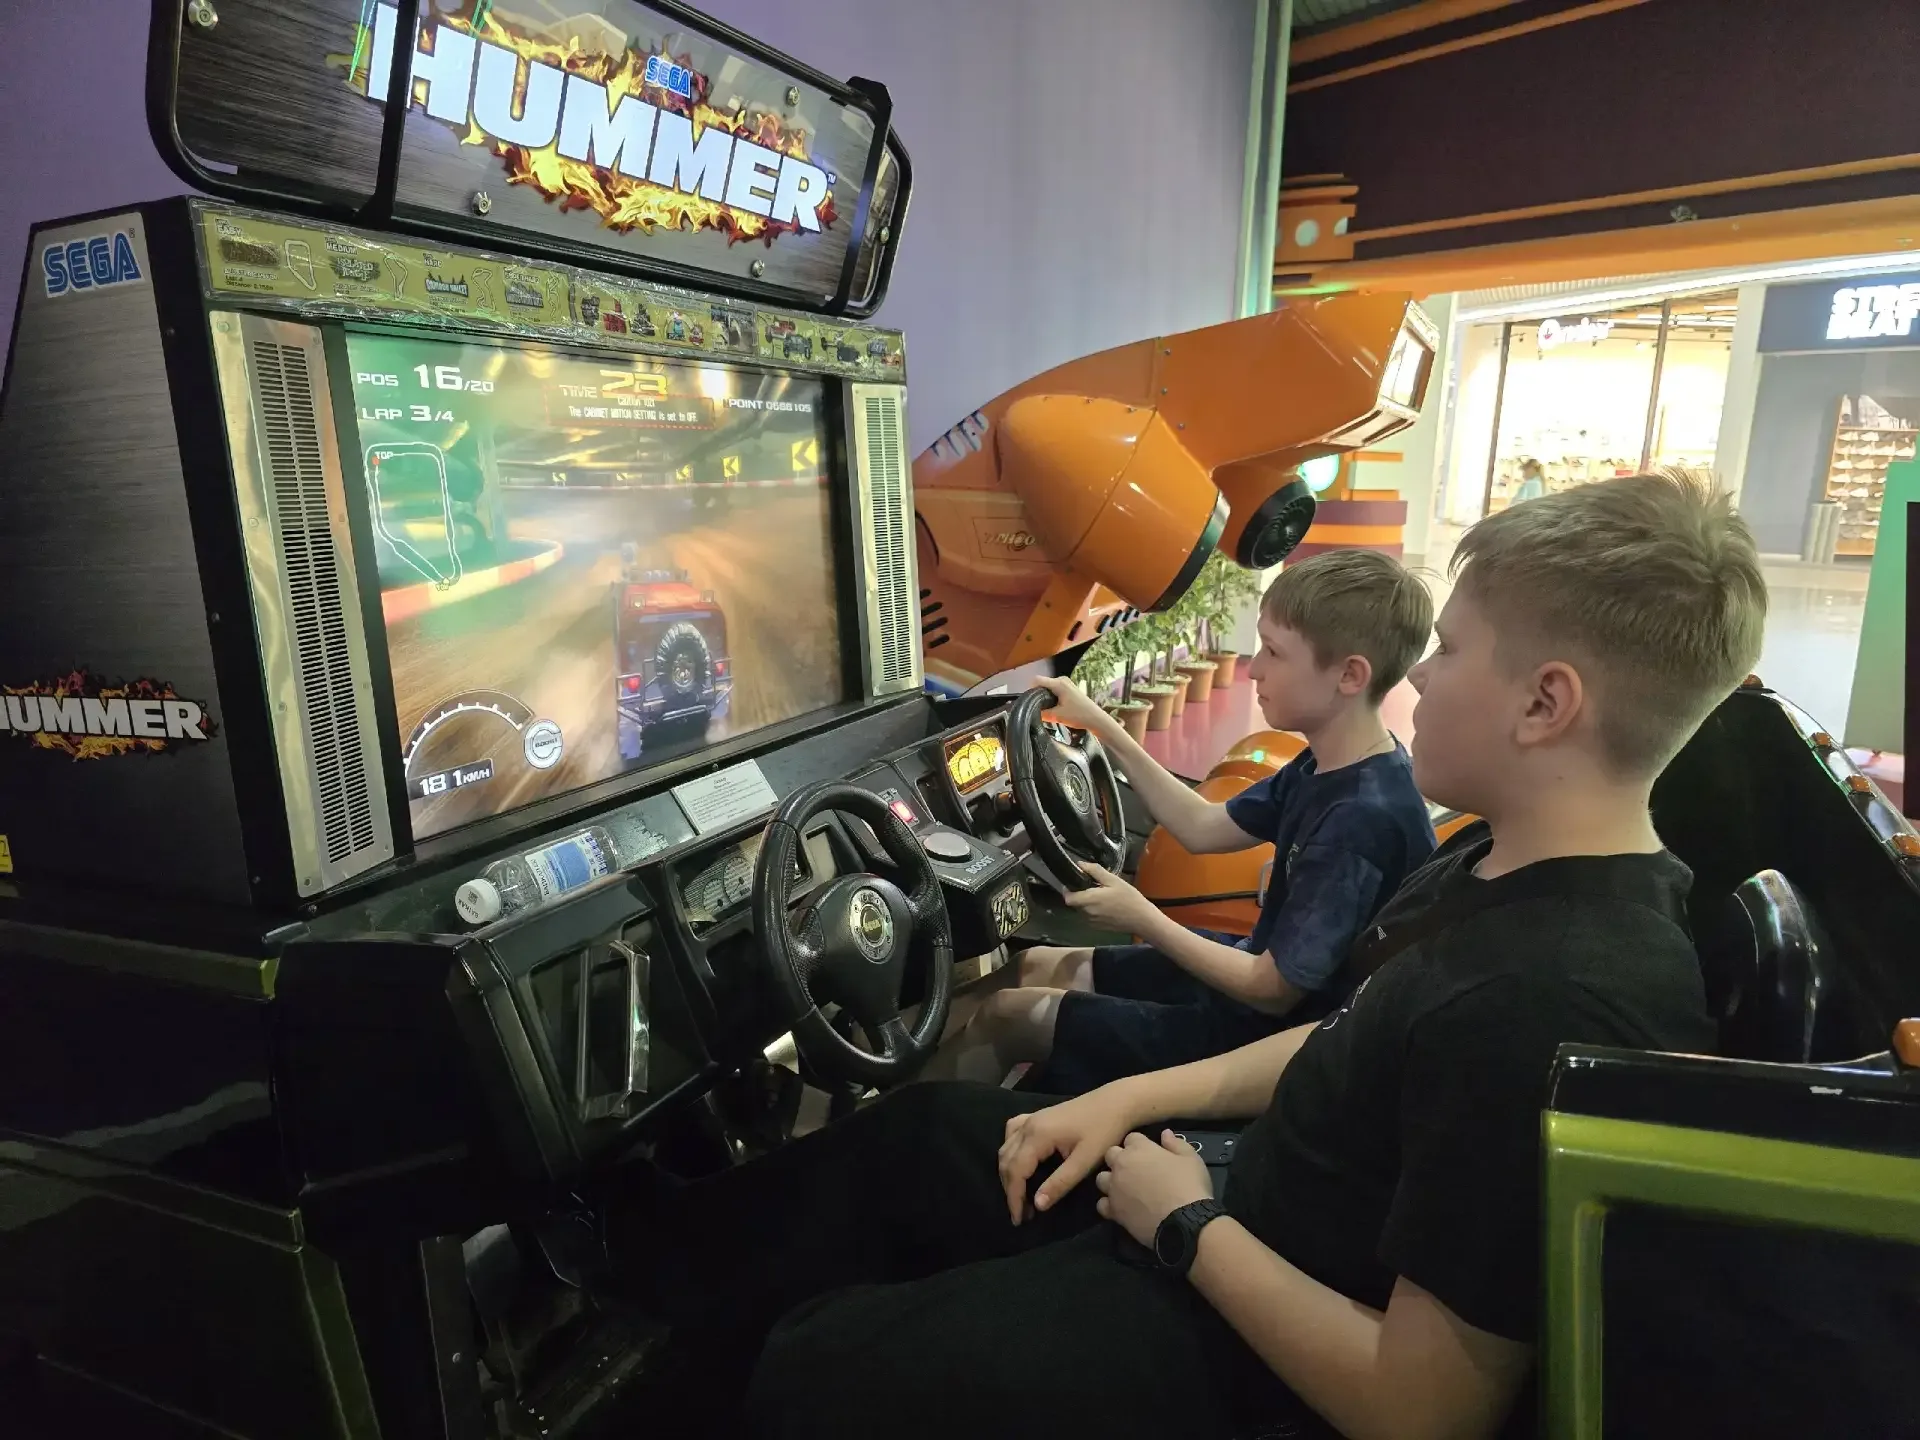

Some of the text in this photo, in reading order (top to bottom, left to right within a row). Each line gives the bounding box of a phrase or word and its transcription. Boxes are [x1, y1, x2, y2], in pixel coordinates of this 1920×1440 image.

[645, 56, 690, 98] SEGA
[368, 2, 828, 233] HUMMER
[326, 242, 358, 255] MEDIUM
[44, 232, 142, 296] SEGA
[357, 373, 399, 388] POS
[559, 384, 597, 399] TIME
[728, 399, 763, 411] POINT
[361, 408, 403, 421] LAP
[633, 410, 657, 421] SETTING
[375, 451, 394, 460] TOP
[0, 695, 208, 740] UMMER
[966, 855, 995, 874] BOOST
